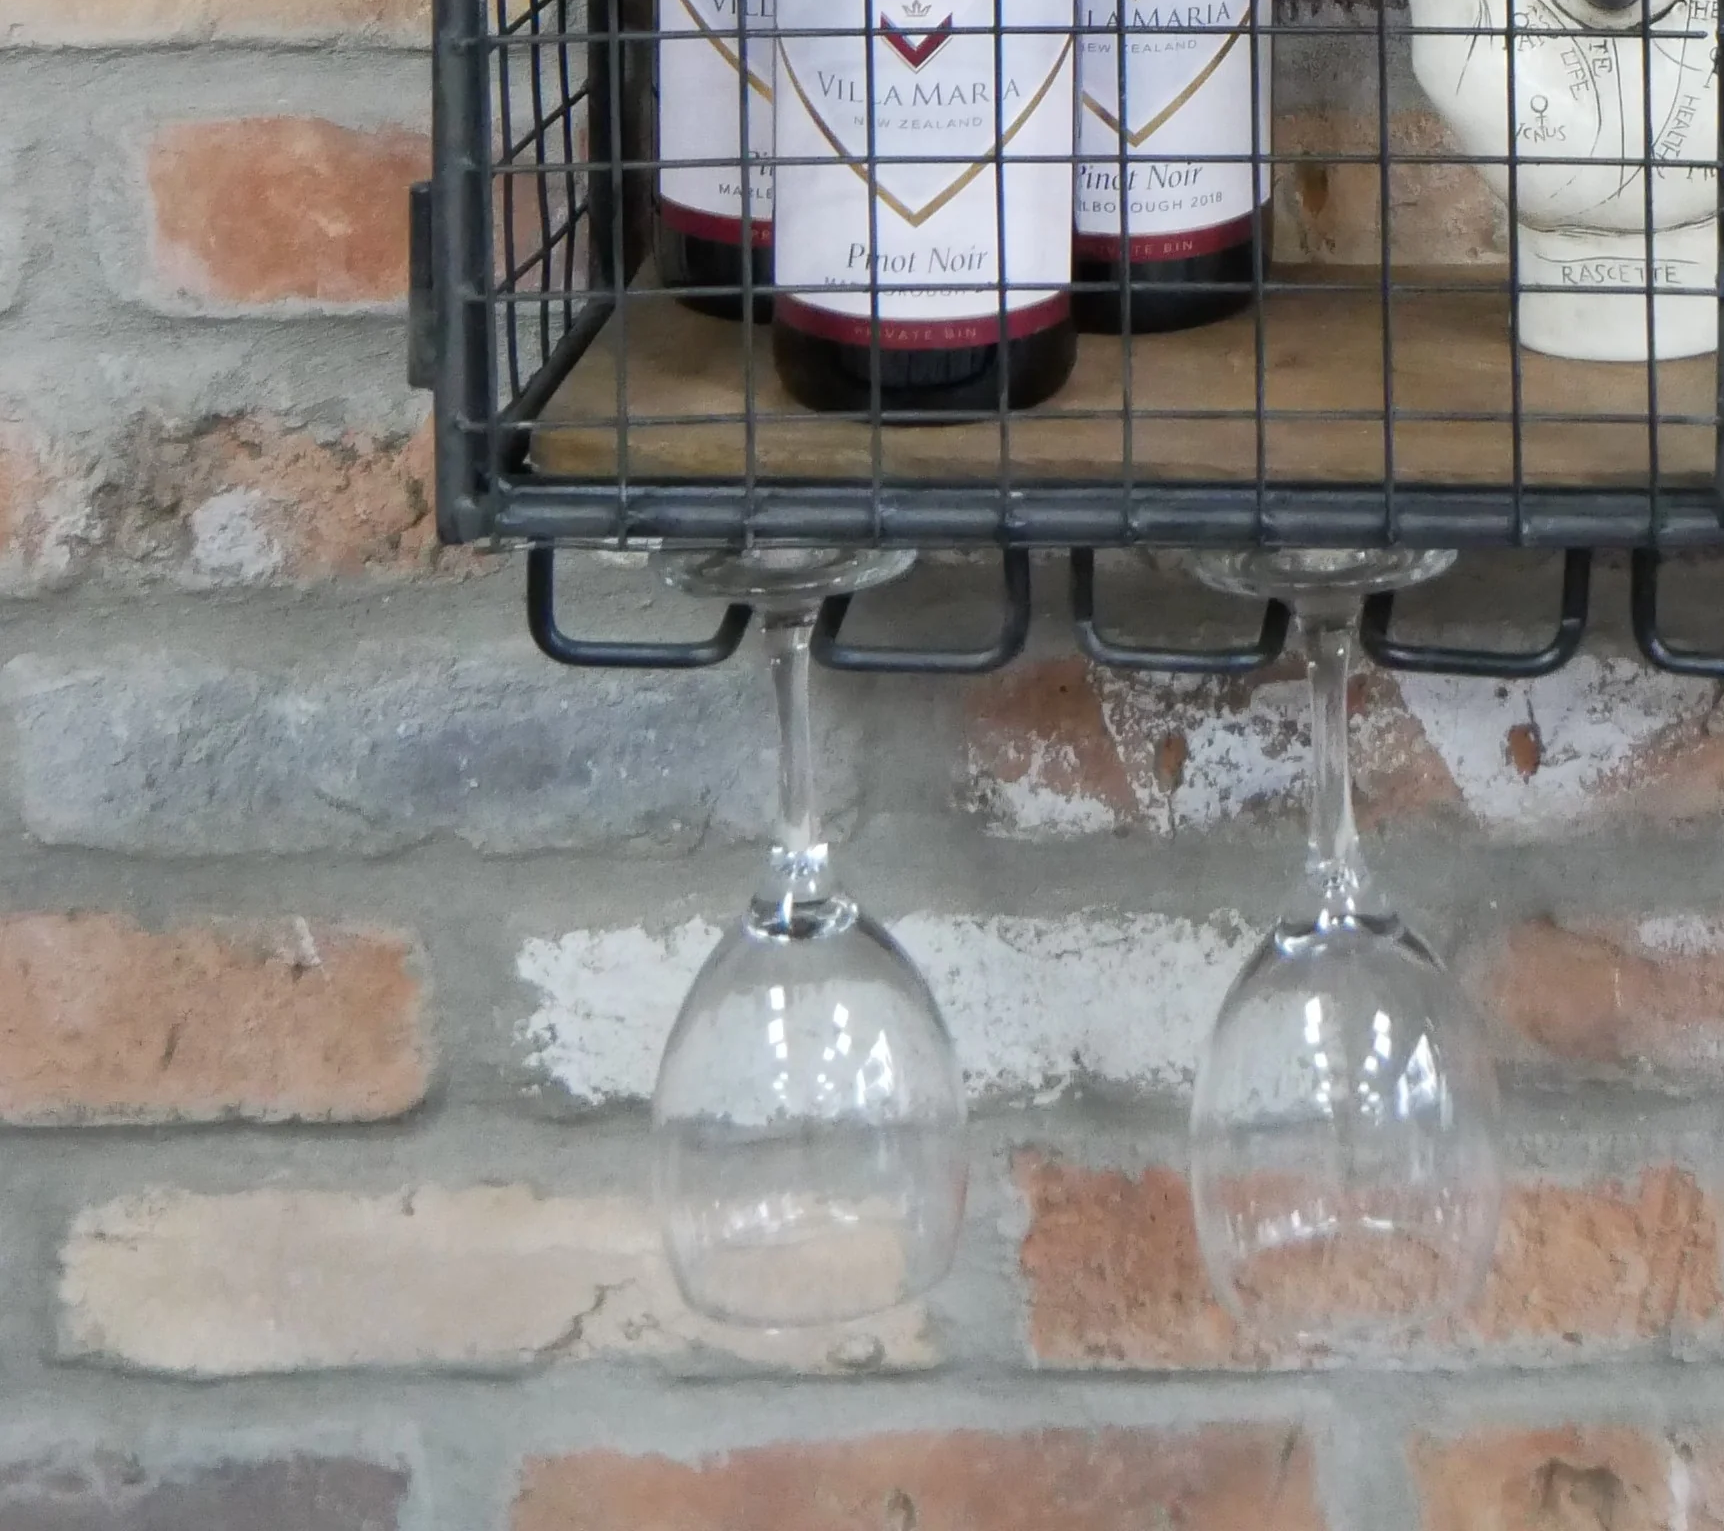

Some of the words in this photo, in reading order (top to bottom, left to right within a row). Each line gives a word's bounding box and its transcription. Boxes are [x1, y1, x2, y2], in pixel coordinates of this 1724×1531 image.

[1133, 1, 1230, 29] MARIA
[1126, 39, 1197, 54] EALAND
[912, 78, 1020, 107] MARA
[853, 115, 890, 128] NW
[899, 116, 983, 129] ZEALAND
[1147, 161, 1203, 190] Noir
[1191, 191, 1223, 208] 2018
[1163, 241, 1193, 253] BIN
[928, 244, 988, 273] Noir
